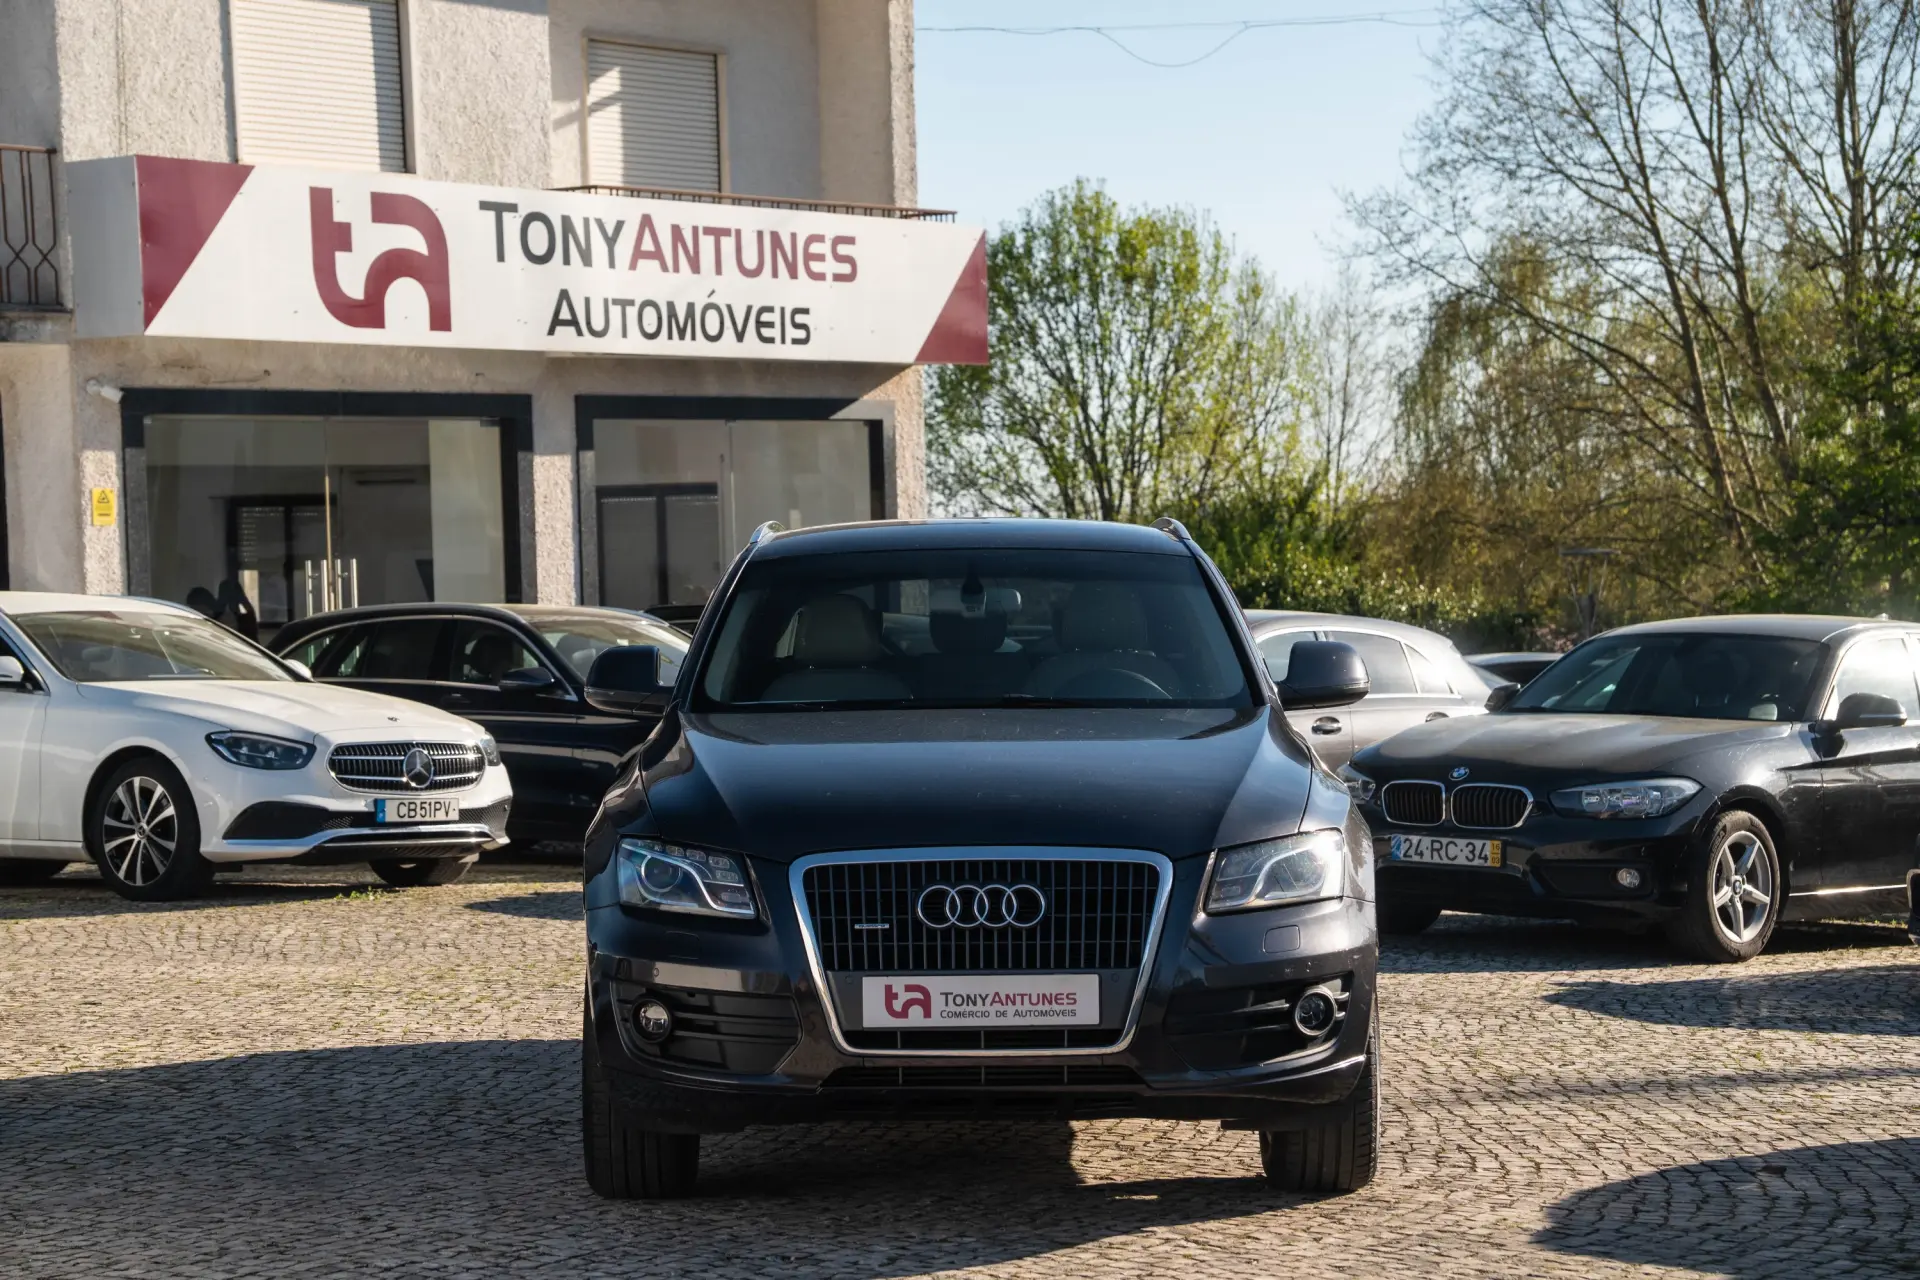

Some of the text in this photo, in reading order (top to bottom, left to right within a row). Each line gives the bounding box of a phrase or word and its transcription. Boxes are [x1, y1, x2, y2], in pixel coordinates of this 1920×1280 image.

[547, 288, 811, 346] AUTOMÓVEIS
[940, 1007, 1077, 1019] COMÉRCIO DE AUTOMÓVEIS
